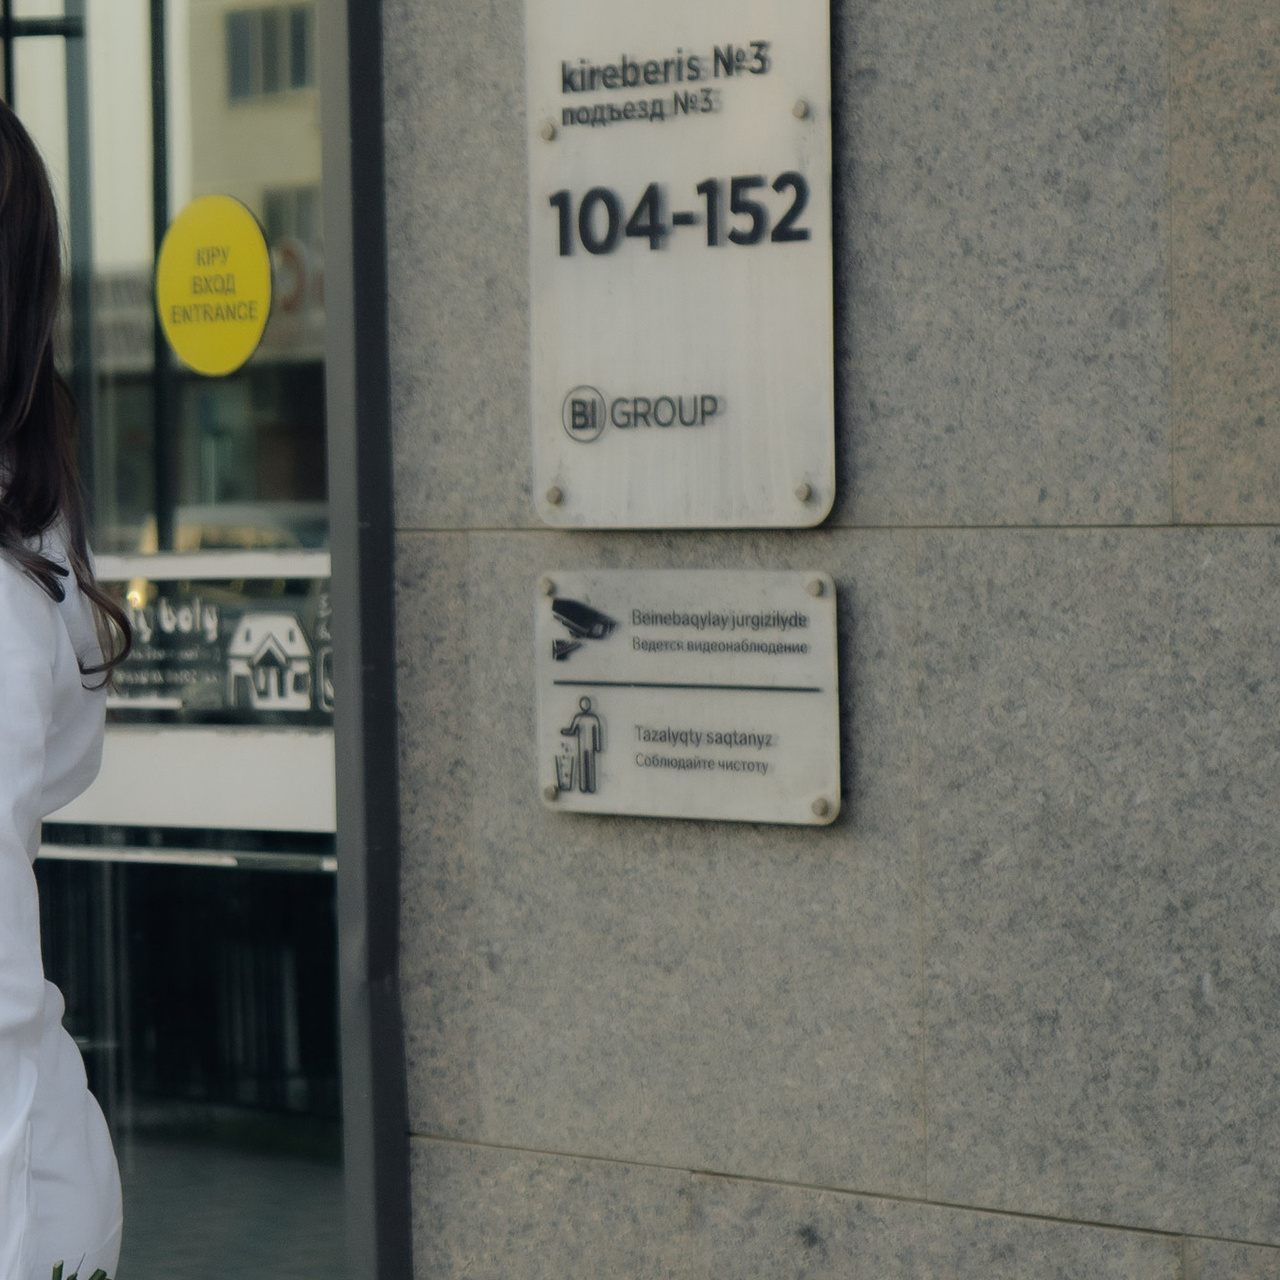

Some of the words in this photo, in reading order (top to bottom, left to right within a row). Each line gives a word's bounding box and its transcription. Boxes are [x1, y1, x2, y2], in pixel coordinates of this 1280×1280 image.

[561, 47, 703, 94] kireberis
[713, 40, 772, 78] №3
[561, 97, 666, 127] подъезд
[548, 171, 812, 257] 104-152
[192, 272, 236, 296] ВХОД
[170, 300, 260, 325] ENTRANCE
[571, 398, 598, 430] BI
[610, 394, 719, 430] GROUP
